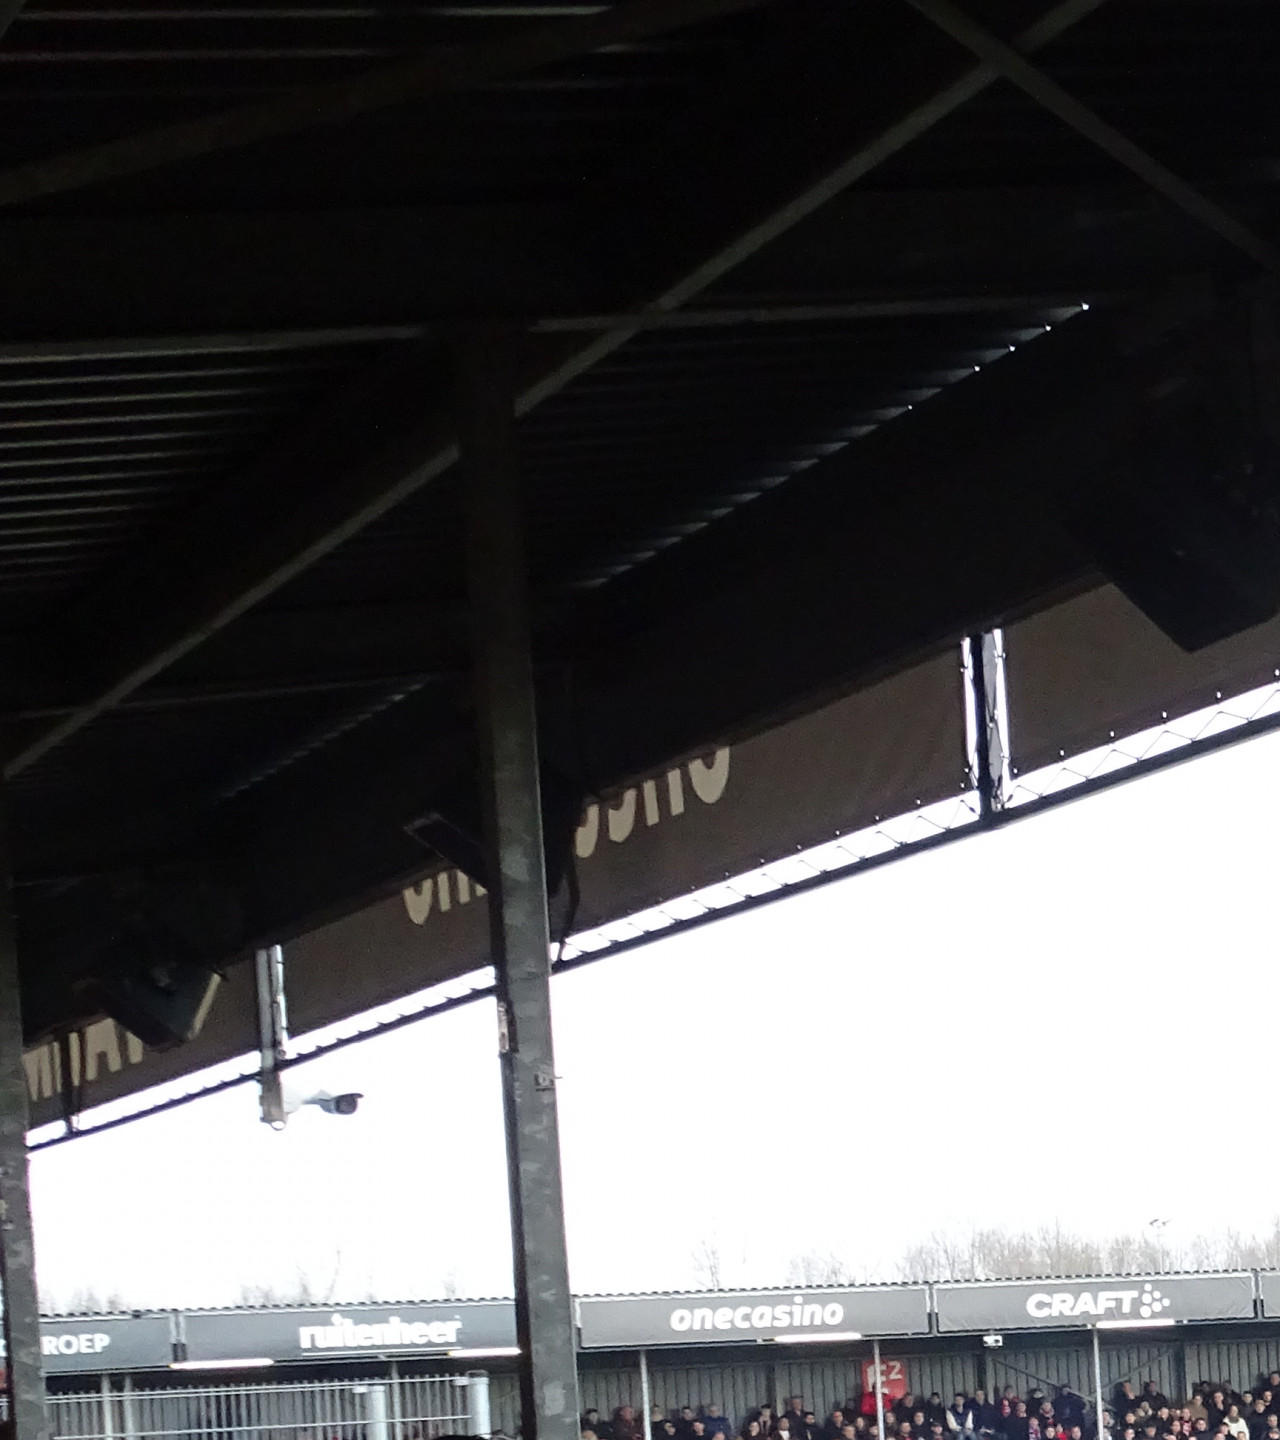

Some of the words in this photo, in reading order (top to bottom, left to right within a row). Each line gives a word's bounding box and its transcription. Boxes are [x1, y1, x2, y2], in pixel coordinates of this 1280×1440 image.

[670, 1296, 844, 1332] onecasino
[1026, 1290, 1139, 1318] CRAFT
[40, 1333, 110, 1355] ROEP
